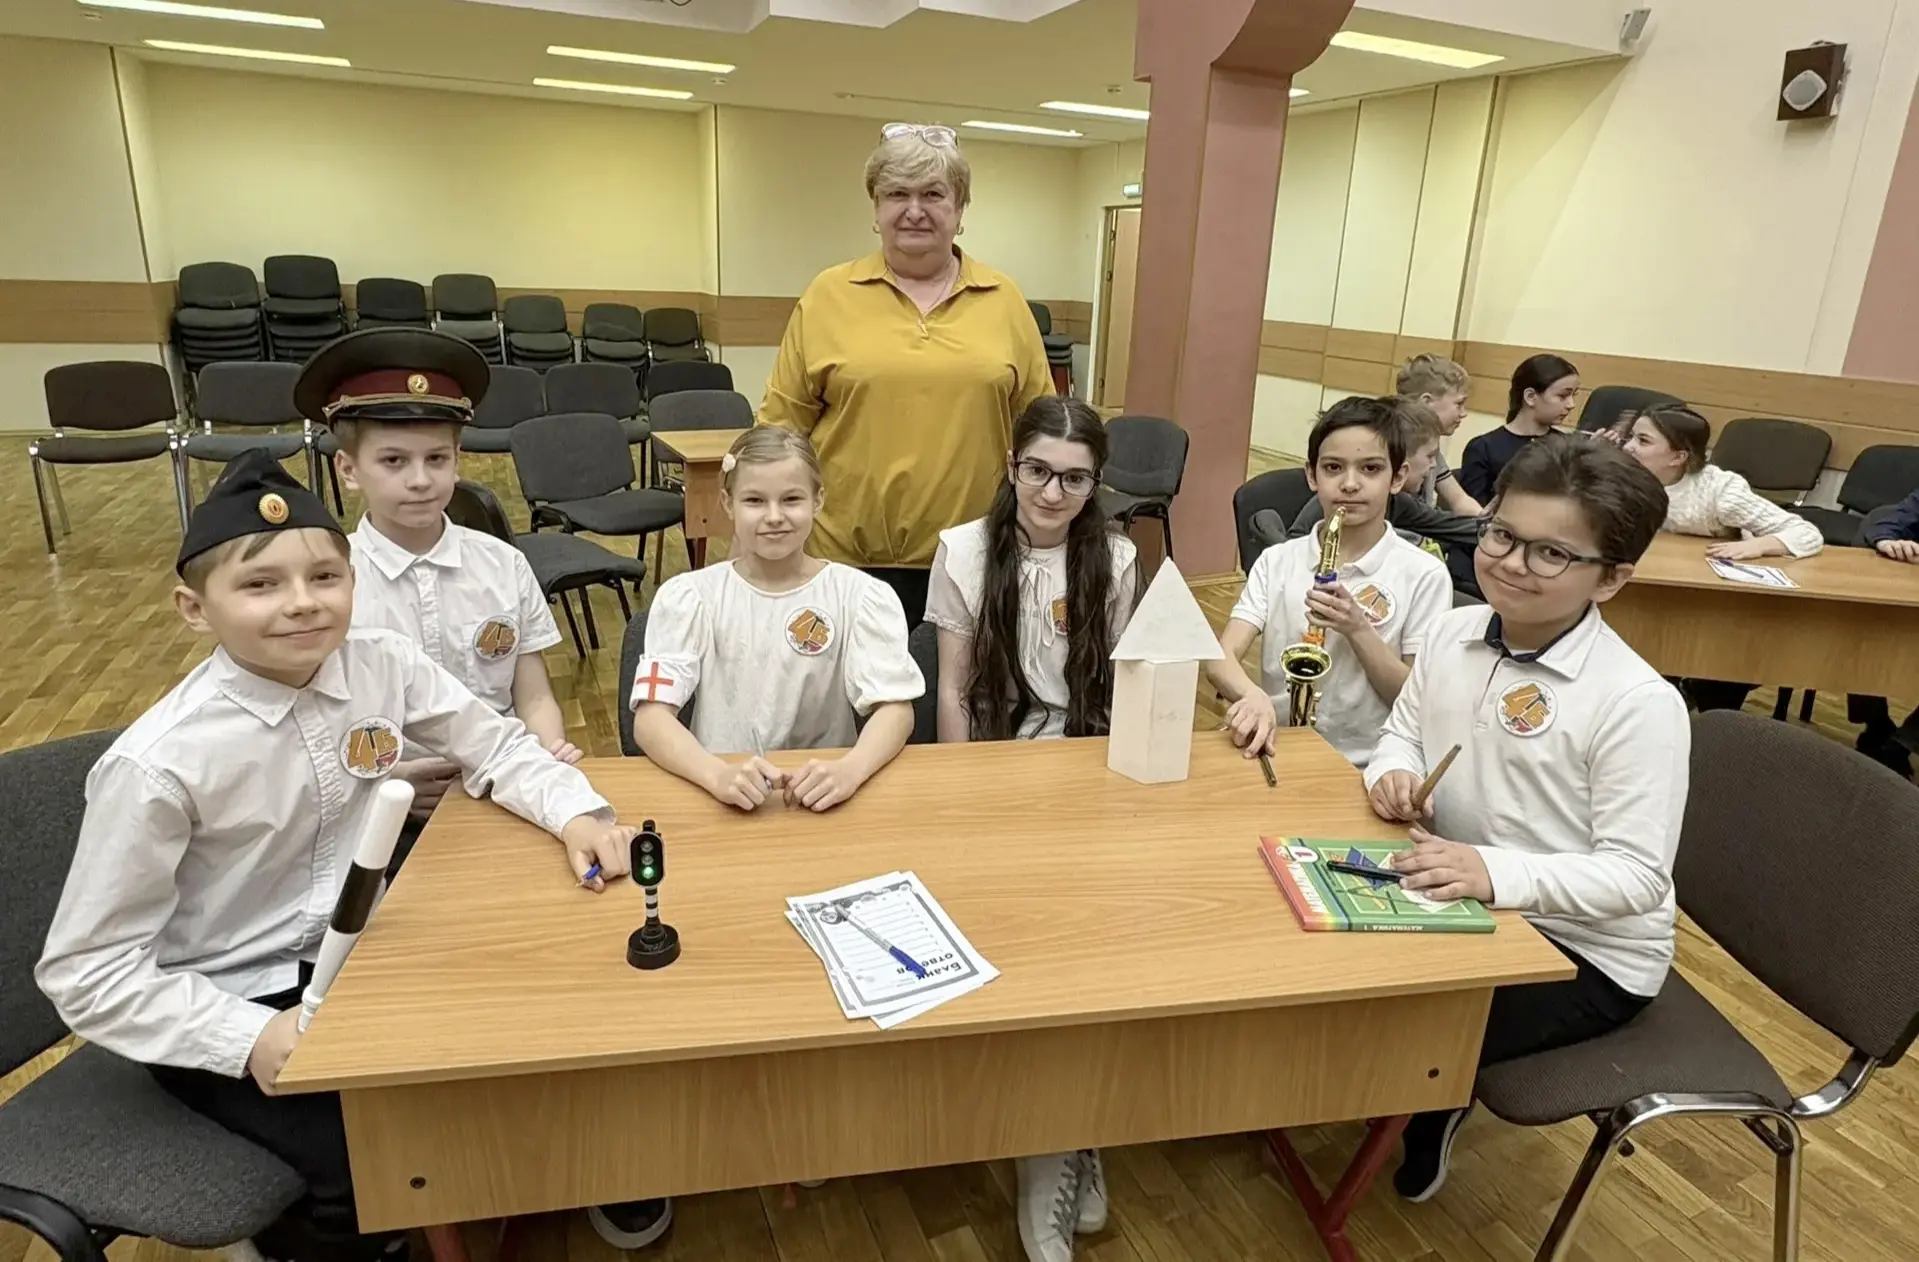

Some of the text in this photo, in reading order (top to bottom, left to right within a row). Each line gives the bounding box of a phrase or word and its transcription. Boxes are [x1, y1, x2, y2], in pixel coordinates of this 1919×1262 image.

[1372, 924, 1424, 932] МАТЕМАТИКА
[896, 952, 954, 976] отвеов
[916, 962, 962, 981] Бланк
